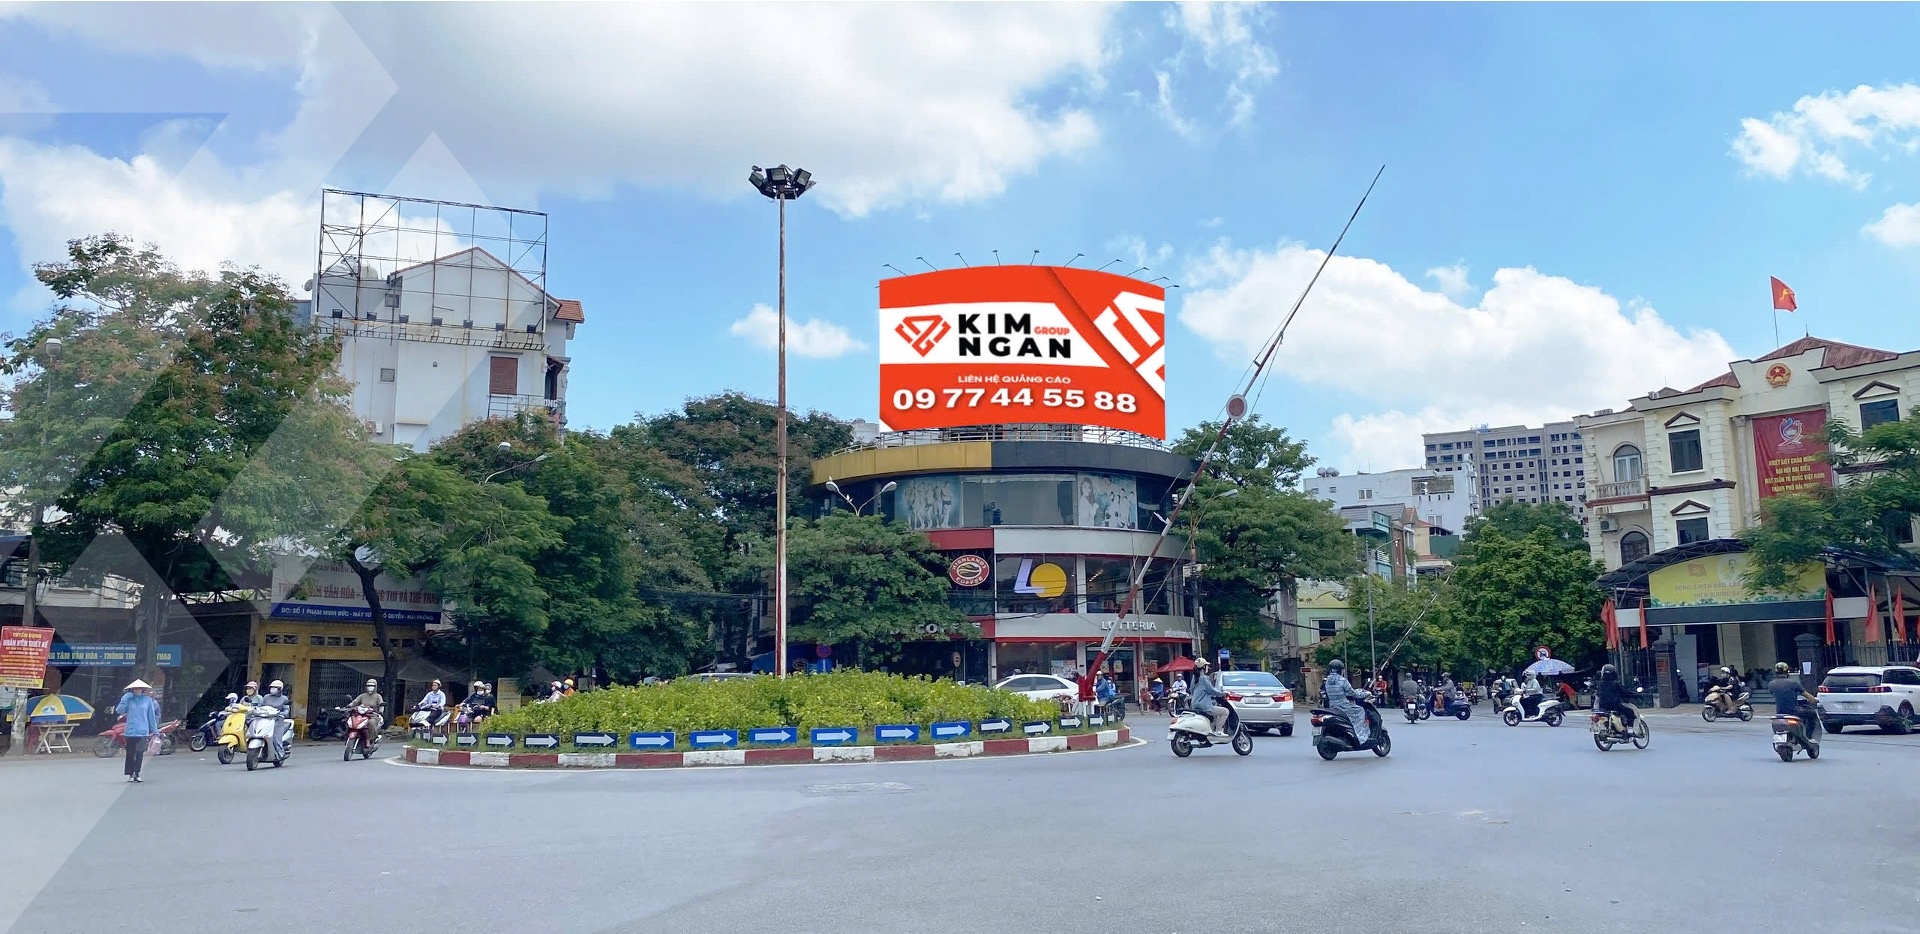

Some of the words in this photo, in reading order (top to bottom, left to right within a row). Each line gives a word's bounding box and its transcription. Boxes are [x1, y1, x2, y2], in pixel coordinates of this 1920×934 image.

[958, 313, 1031, 335] KIM
[1033, 326, 1070, 336] GROUP
[958, 336, 1071, 359] NGAN
[958, 375, 982, 384] LIÊN
[984, 375, 1001, 385] HỆ
[1002, 374, 1043, 384] QUẢNG
[1045, 375, 1071, 385] CÁO
[892, 388, 937, 411] 09
[942, 387, 986, 408] 77
[990, 387, 1034, 407] 44
[1042, 388, 1086, 408] 55
[1093, 390, 1138, 413] 88
[952, 557, 987, 570] HIGHLANDS
[956, 576, 984, 585] COFFEE
